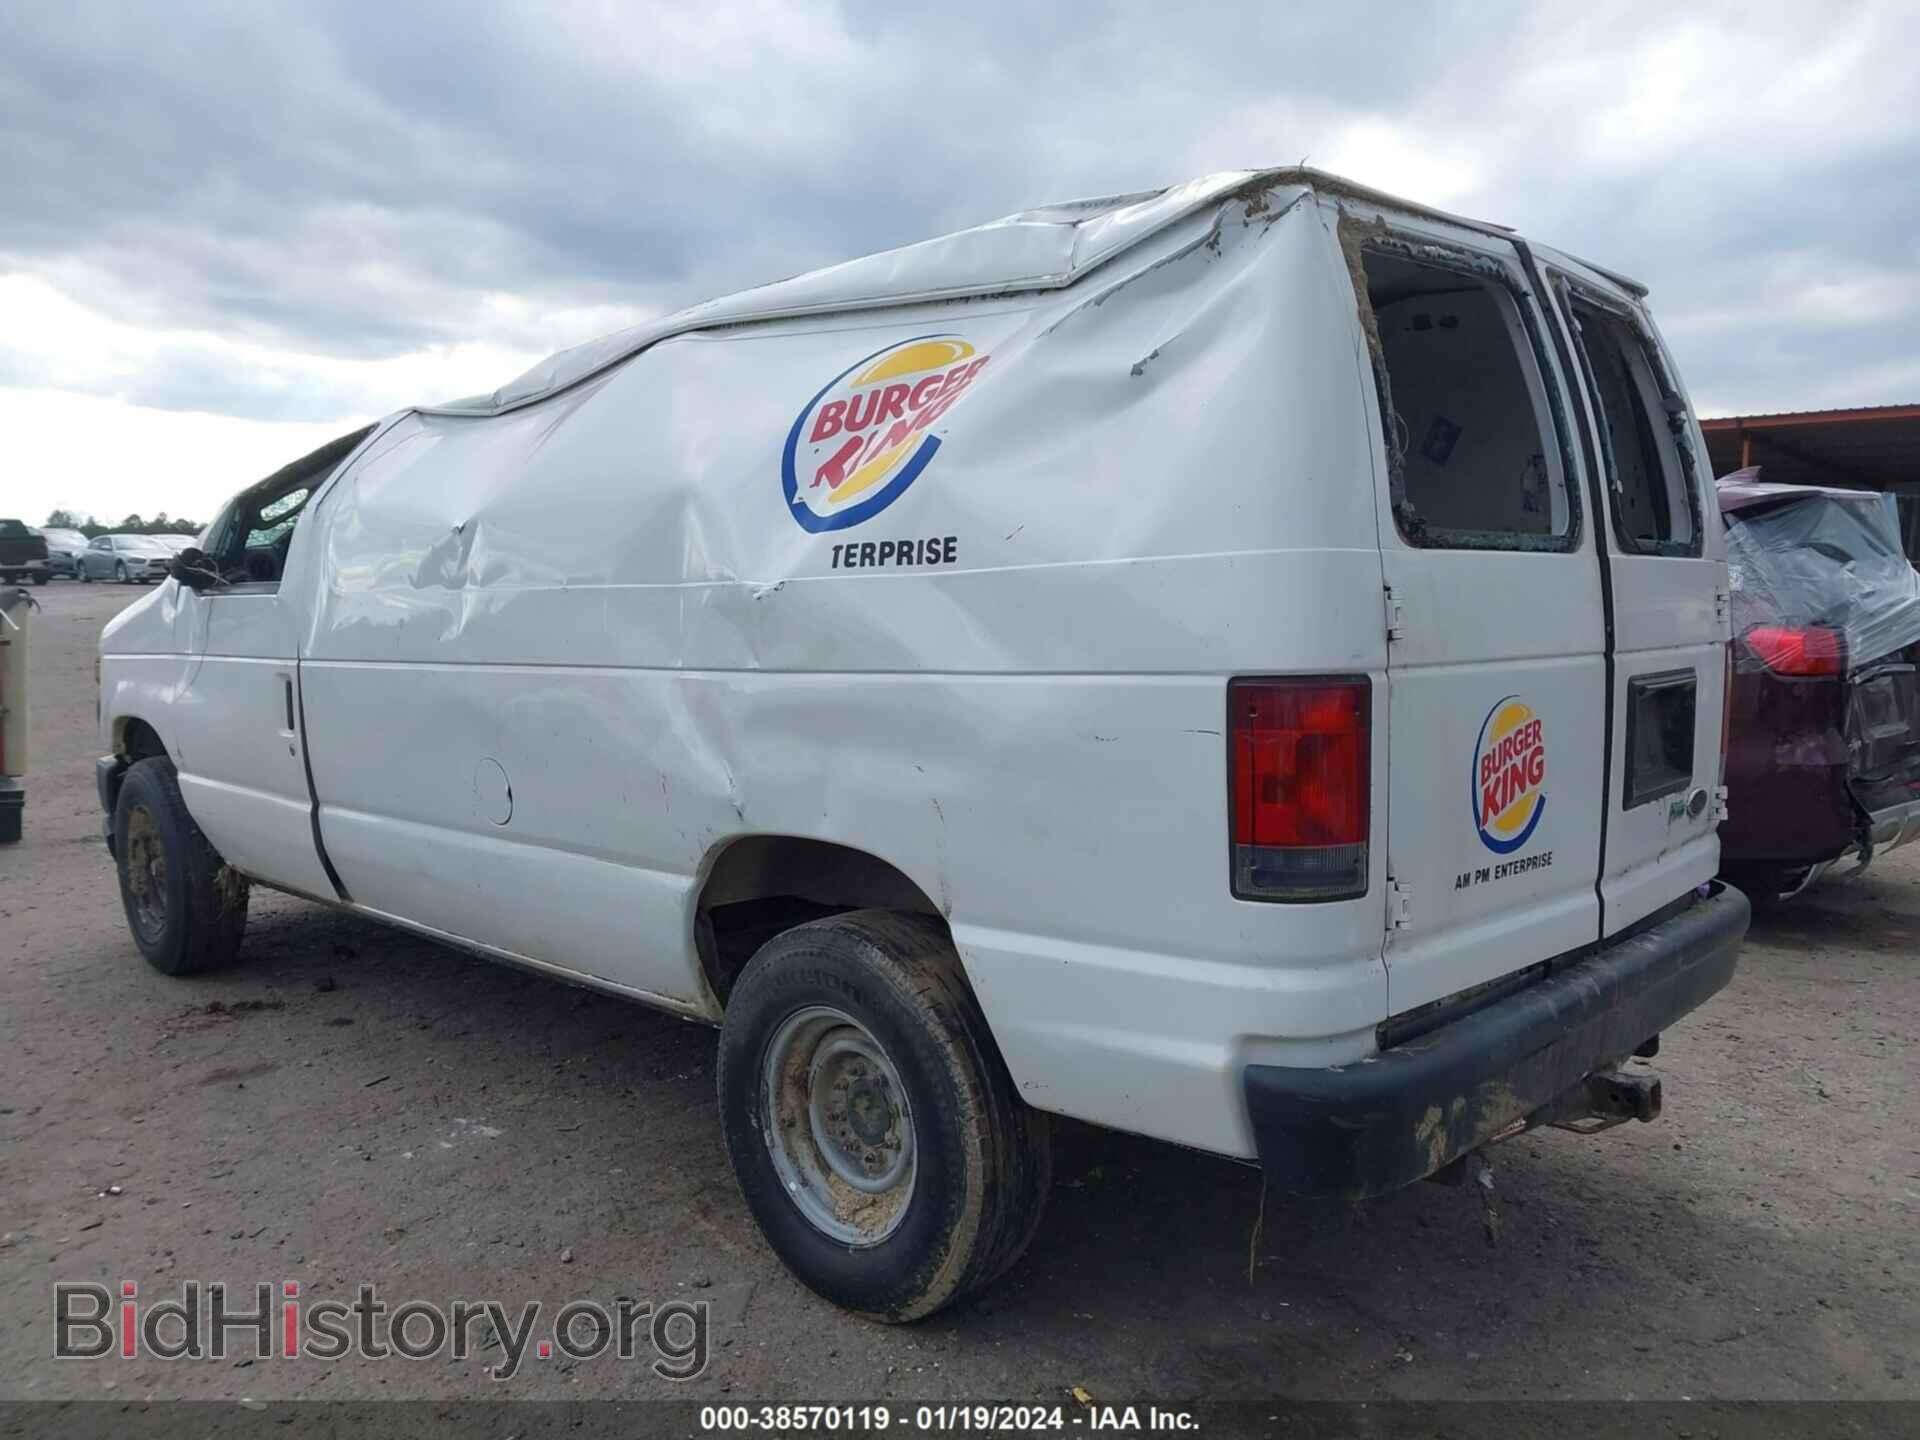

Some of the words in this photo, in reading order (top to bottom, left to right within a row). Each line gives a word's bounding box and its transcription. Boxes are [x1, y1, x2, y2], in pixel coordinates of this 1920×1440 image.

[809, 355, 991, 443] BURGER
[831, 536, 957, 568] TERPRISE
[1481, 719, 1542, 787] BURGER
[1481, 745, 1545, 829] KING
[1455, 873, 1471, 890] AM
[1474, 868, 1490, 885] PM
[1494, 851, 1553, 880] ENTERPRISE
